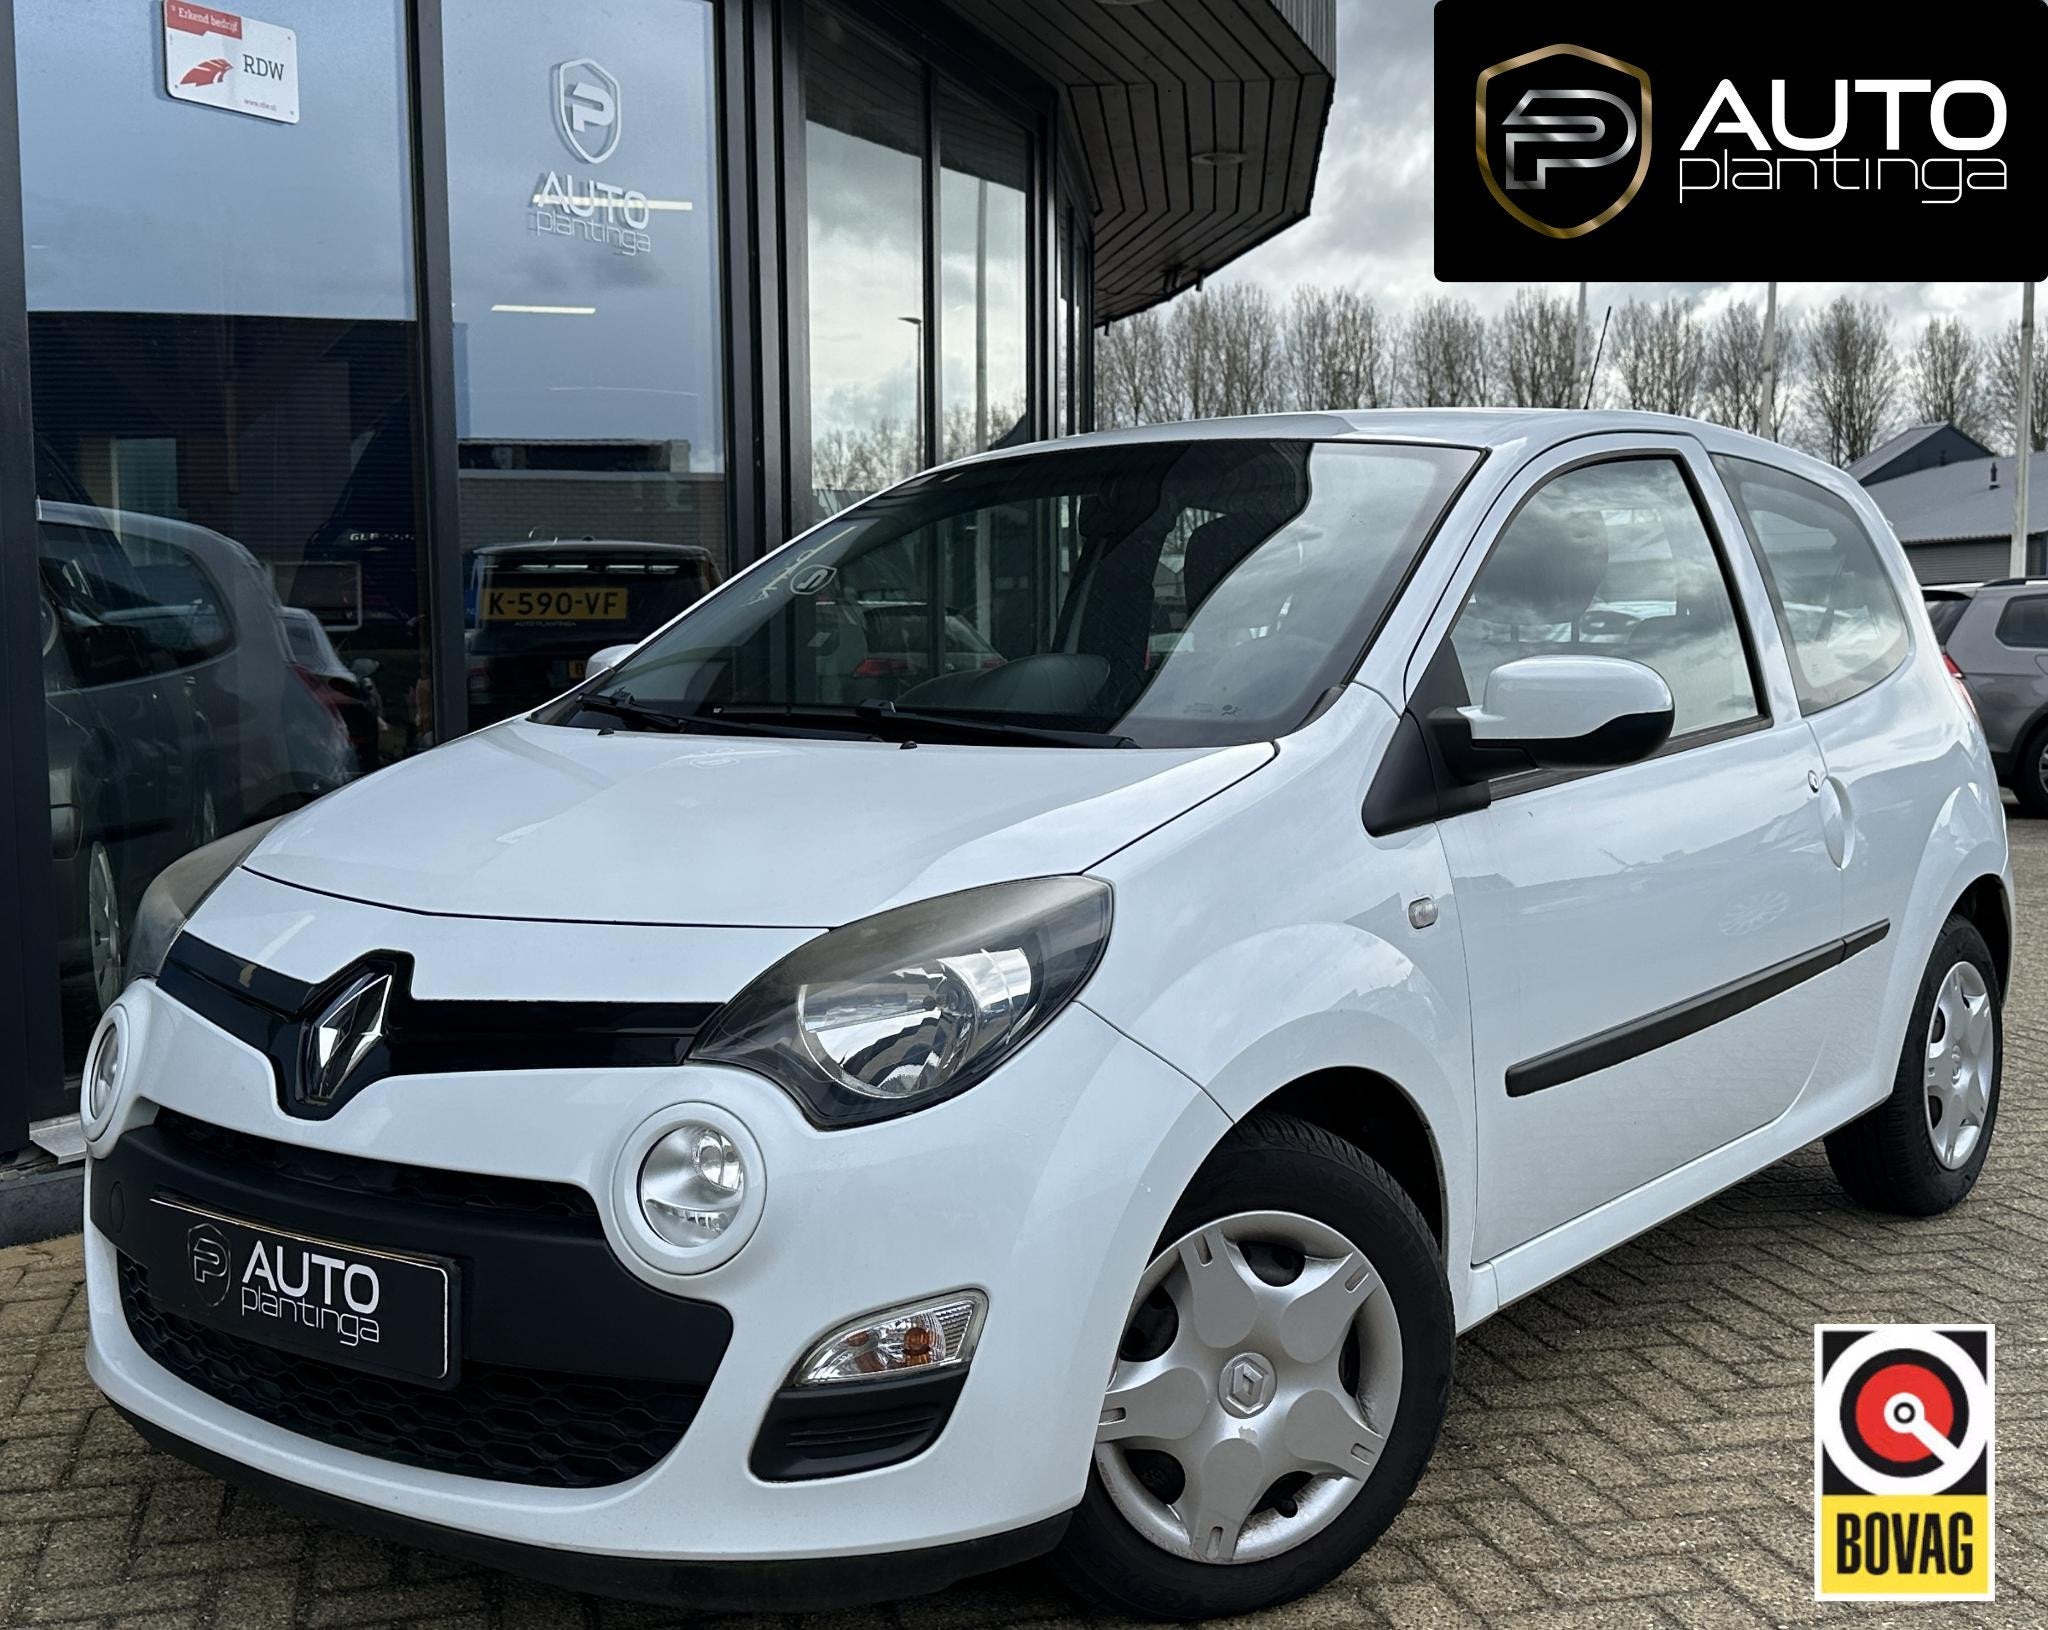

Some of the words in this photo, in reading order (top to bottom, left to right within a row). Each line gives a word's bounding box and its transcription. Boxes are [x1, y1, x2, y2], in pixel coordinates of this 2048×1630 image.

[178, 7, 209, 25] Erkend
[242, 53, 285, 81] RDW
[537, 171, 650, 230] AUTO
[535, 209, 651, 256] plantinga
[488, 592, 619, 616] K-590-VF
[242, 1239, 380, 1315] AUTO
[242, 1285, 380, 1347] plantinga
